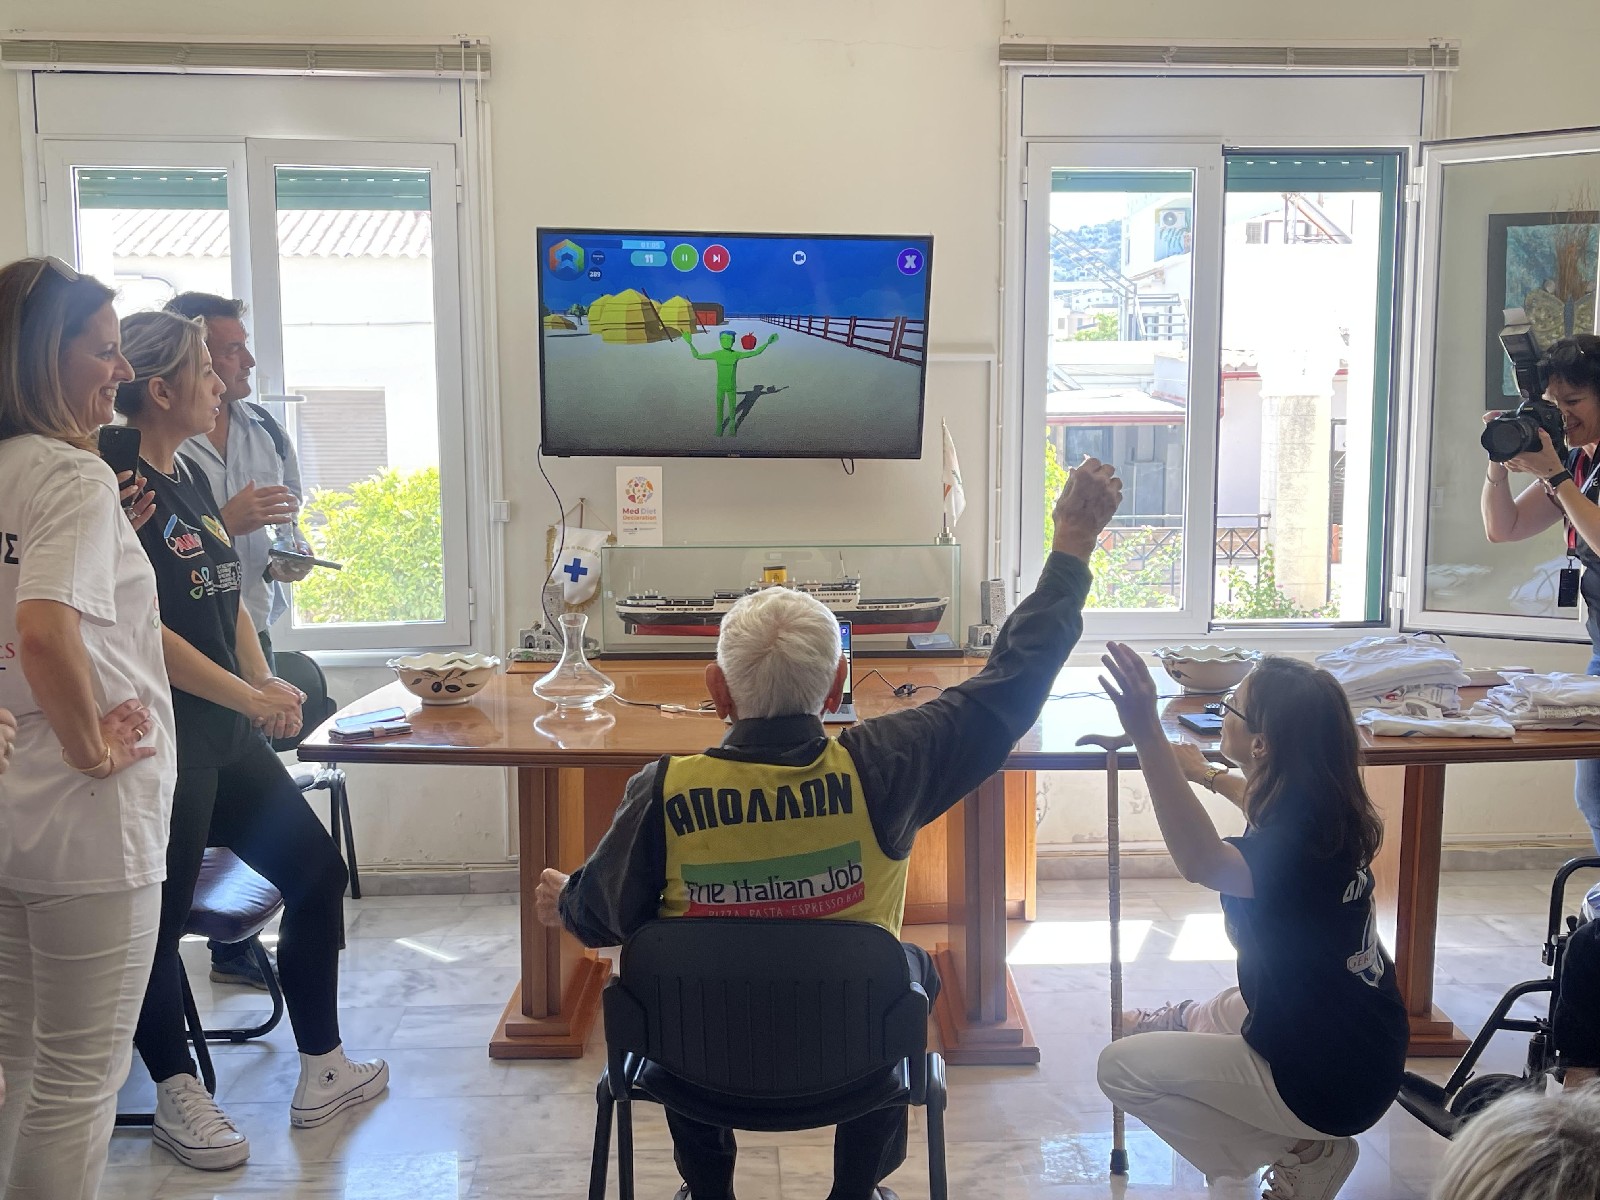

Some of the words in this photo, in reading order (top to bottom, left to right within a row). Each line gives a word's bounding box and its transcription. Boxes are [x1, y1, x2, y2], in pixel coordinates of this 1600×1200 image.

[622, 507, 640, 515] Med
[640, 507, 657, 515] Diet
[665, 771, 853, 837] ΑΠΟΛΛΩΝ
[732, 875, 815, 903] Italian
[821, 860, 863, 893] Job
[750, 906, 783, 918] PASTA
[791, 897, 844, 916] ESPRESSO
